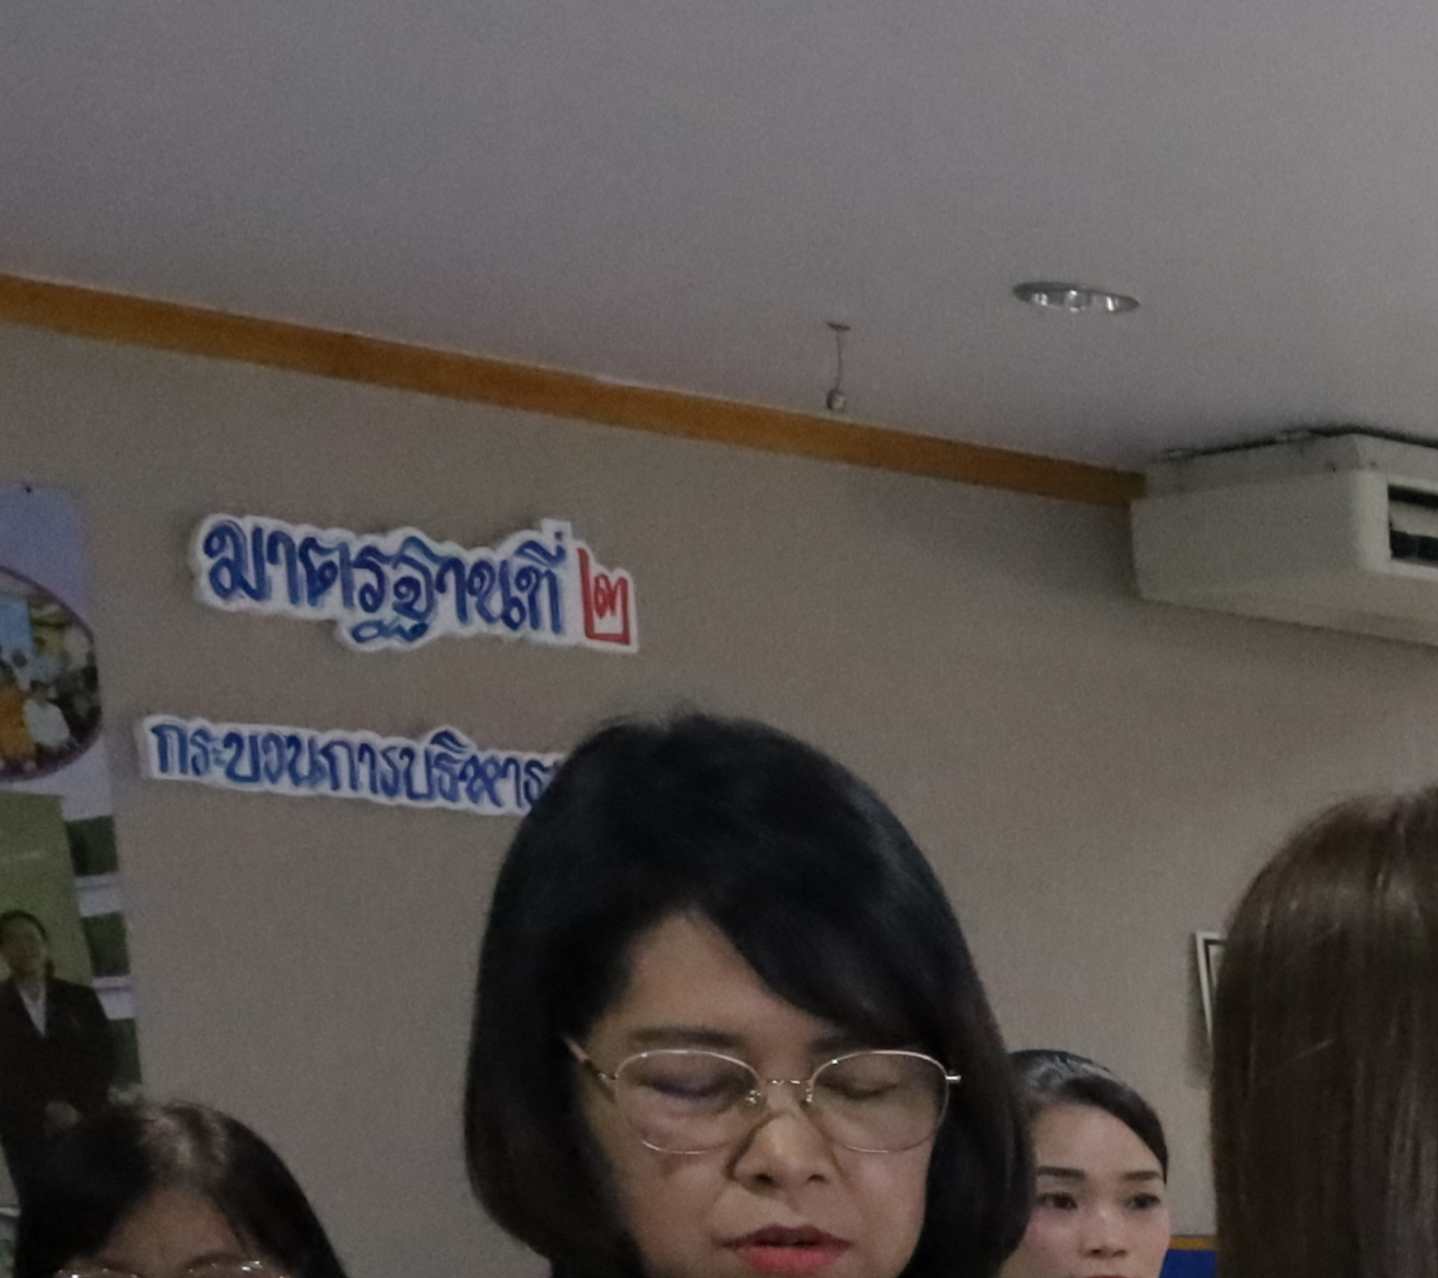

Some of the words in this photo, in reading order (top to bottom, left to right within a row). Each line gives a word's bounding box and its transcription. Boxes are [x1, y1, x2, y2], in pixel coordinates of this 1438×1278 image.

[202, 517, 567, 643] มาตรฐานที่
[151, 723, 562, 811] กระบวนการบริหาร
